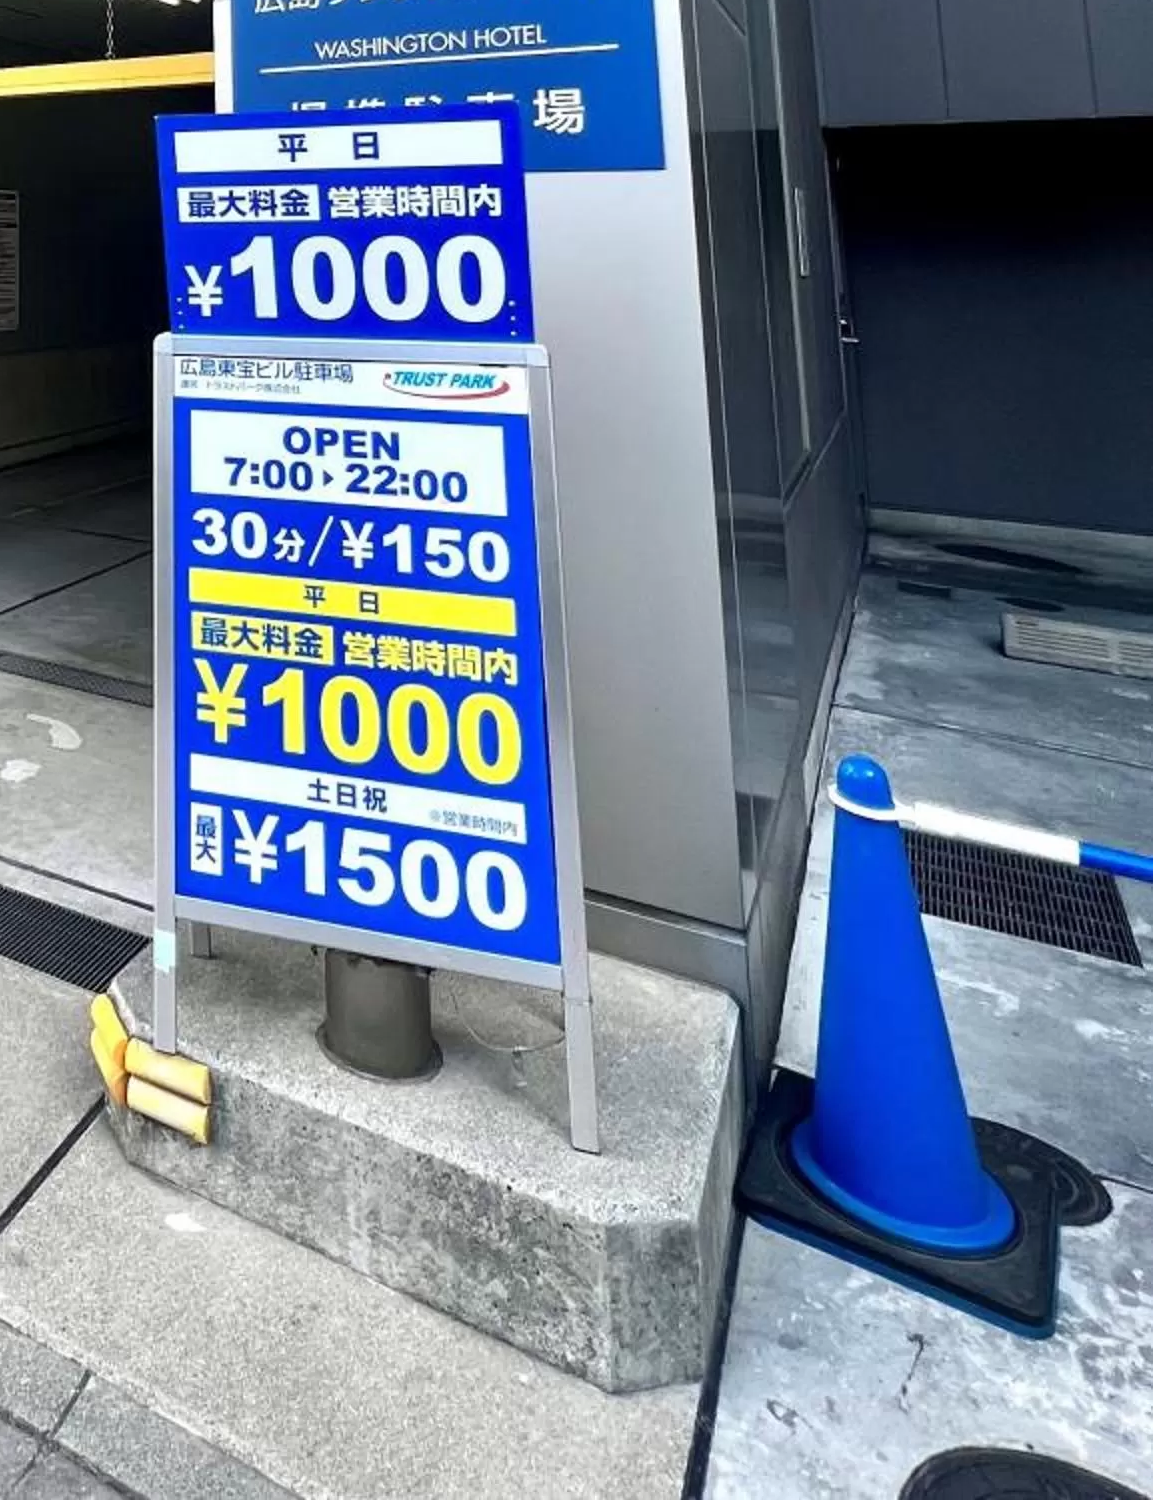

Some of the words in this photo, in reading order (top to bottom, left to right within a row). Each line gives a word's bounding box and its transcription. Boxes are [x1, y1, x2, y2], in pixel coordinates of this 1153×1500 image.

[315, 30, 466, 60] WASHINGTON
[474, 24, 547, 49] HOTEL
[188, 189, 310, 218] 最大料金
[328, 184, 502, 218] 営業時間内
[183, 234, 506, 323] ¥1000
[179, 358, 354, 384] 広島東宝ビル駐車場
[393, 371, 445, 388] TRUST
[448, 373, 497, 390] PARK
[283, 426, 400, 461] OPEN
[199, 617, 325, 661] 最大料金
[342, 630, 519, 687] 営業時間内
[193, 657, 522, 786] ¥1000
[307, 778, 388, 815] 土日祝
[195, 815, 218, 864] 最大
[231, 808, 528, 932] ¥1500
